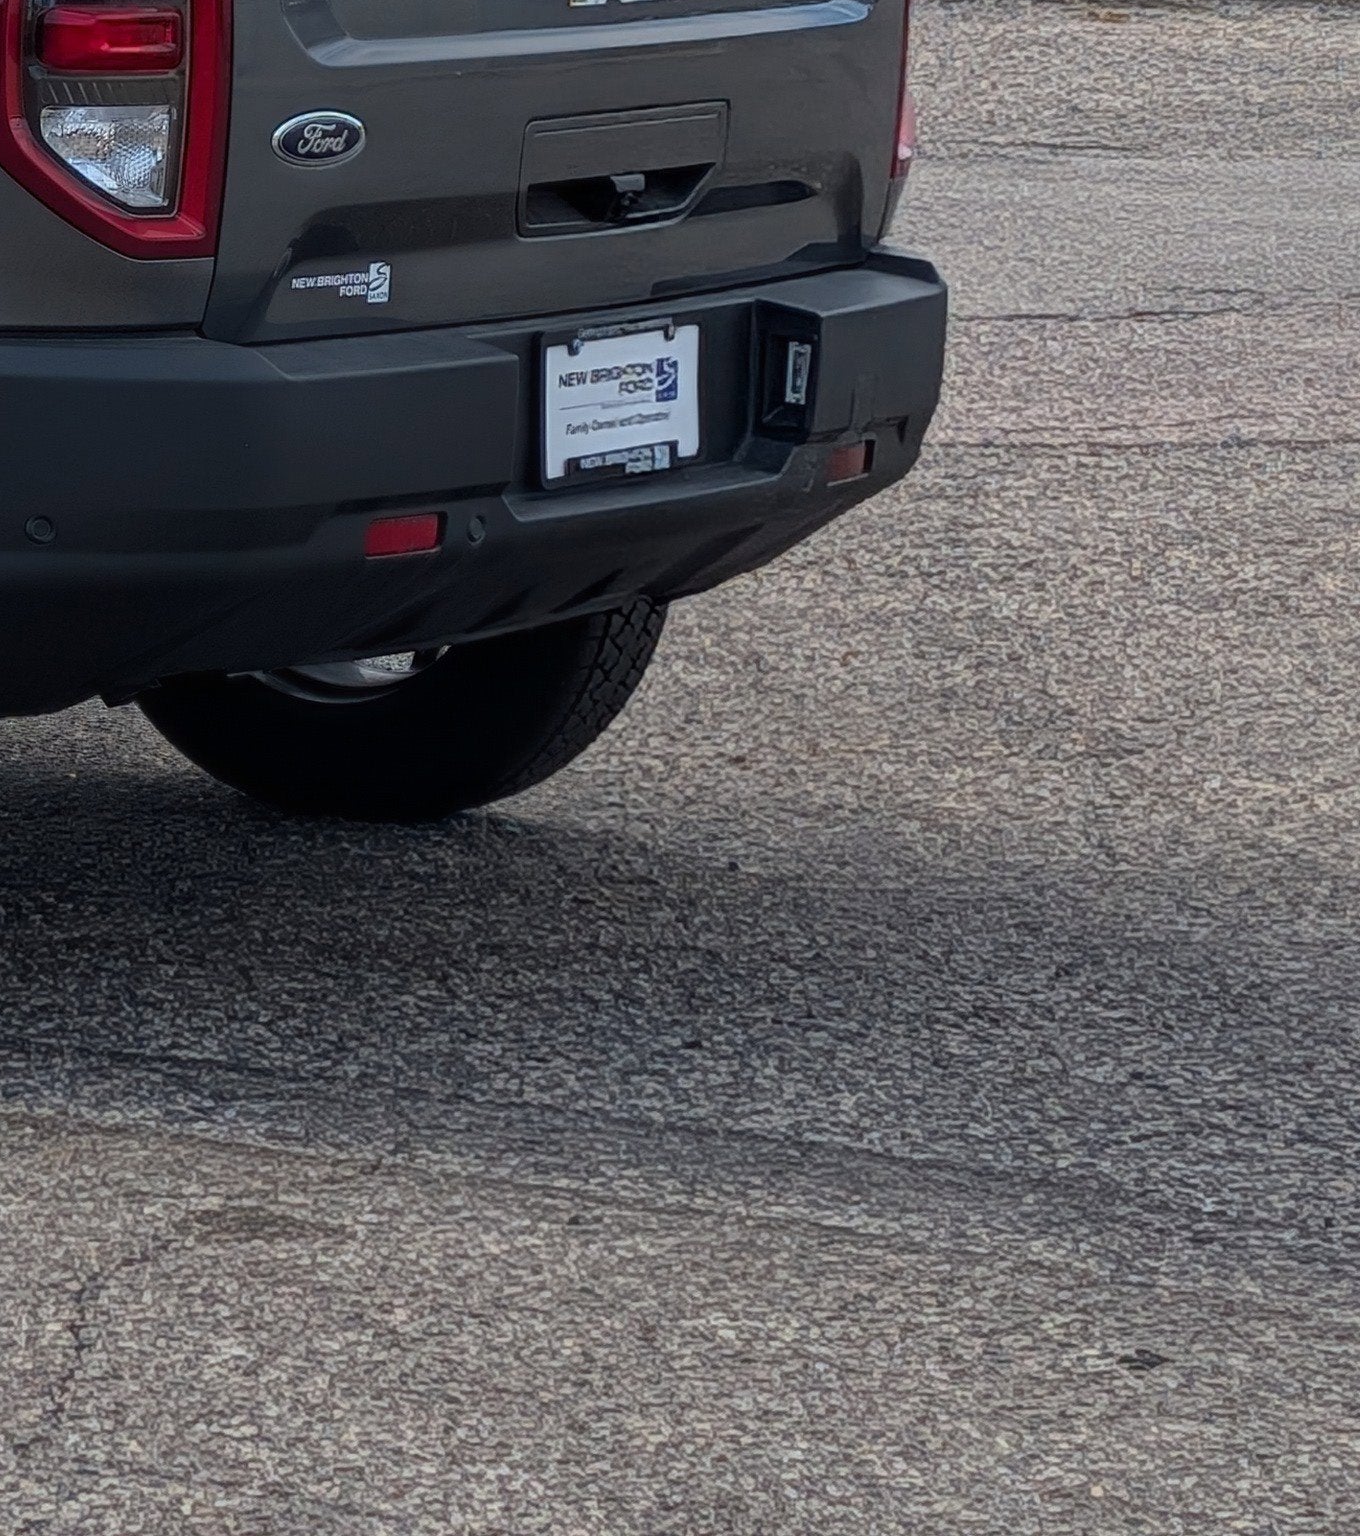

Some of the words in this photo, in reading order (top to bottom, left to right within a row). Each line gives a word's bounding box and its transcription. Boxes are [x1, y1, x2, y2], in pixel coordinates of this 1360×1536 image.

[297, 123, 348, 154] Ford
[291, 277, 316, 290] NEW
[317, 272, 369, 287] BRIGHTON
[340, 284, 367, 297] FORD
[559, 370, 588, 388] NEW
[565, 423, 589, 436] Family
